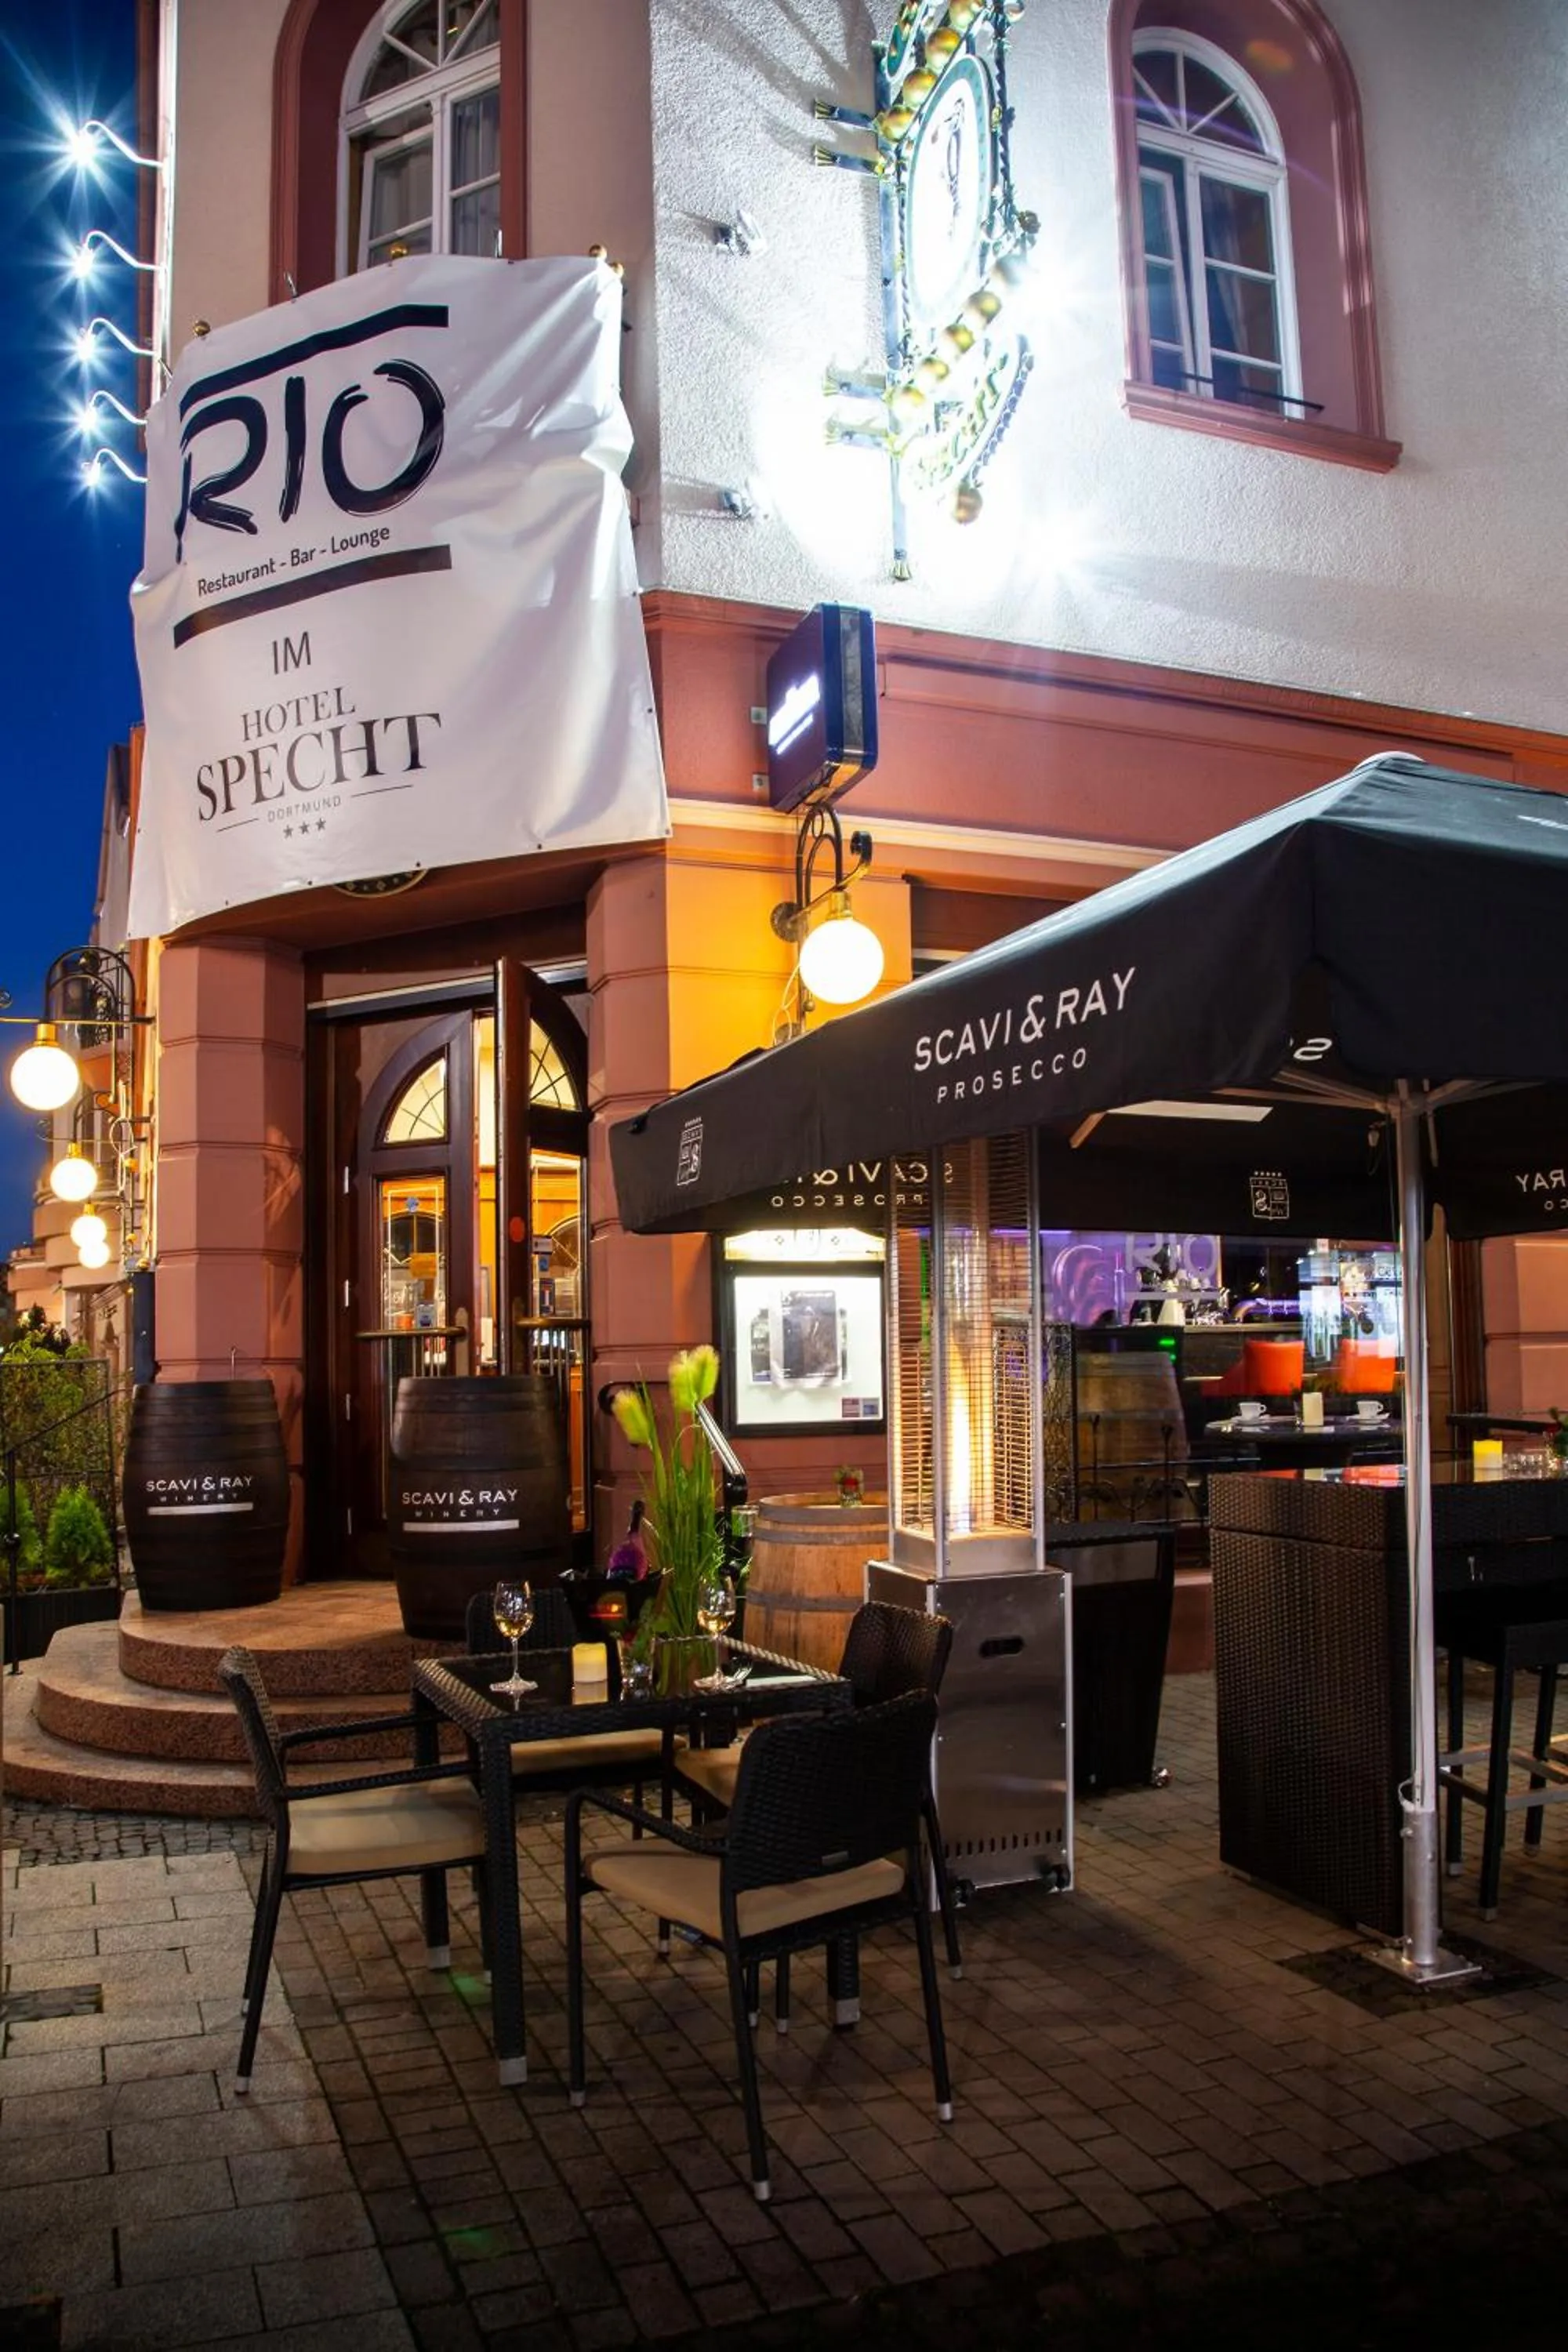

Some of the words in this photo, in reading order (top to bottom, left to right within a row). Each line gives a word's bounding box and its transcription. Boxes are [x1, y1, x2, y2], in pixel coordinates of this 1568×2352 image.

[174, 359, 445, 564] RIO
[198, 557, 276, 597] Restaurant
[290, 548, 317, 567] Bar
[331, 526, 390, 554] Lounge
[272, 631, 312, 675] IM
[241, 685, 356, 742] HOTEL
[197, 713, 441, 822] SPECHT
[267, 794, 343, 822] DORTMUND
[914, 1008, 1012, 1073] SCAVI
[1054, 967, 1135, 1030] RAY
[937, 1047, 1087, 1104] PROSECCO
[146, 1479, 198, 1492] SCAVI
[220, 1475, 252, 1488] RAY
[402, 1492, 454, 1504] SCAVI
[479, 1489, 517, 1503] RAY
